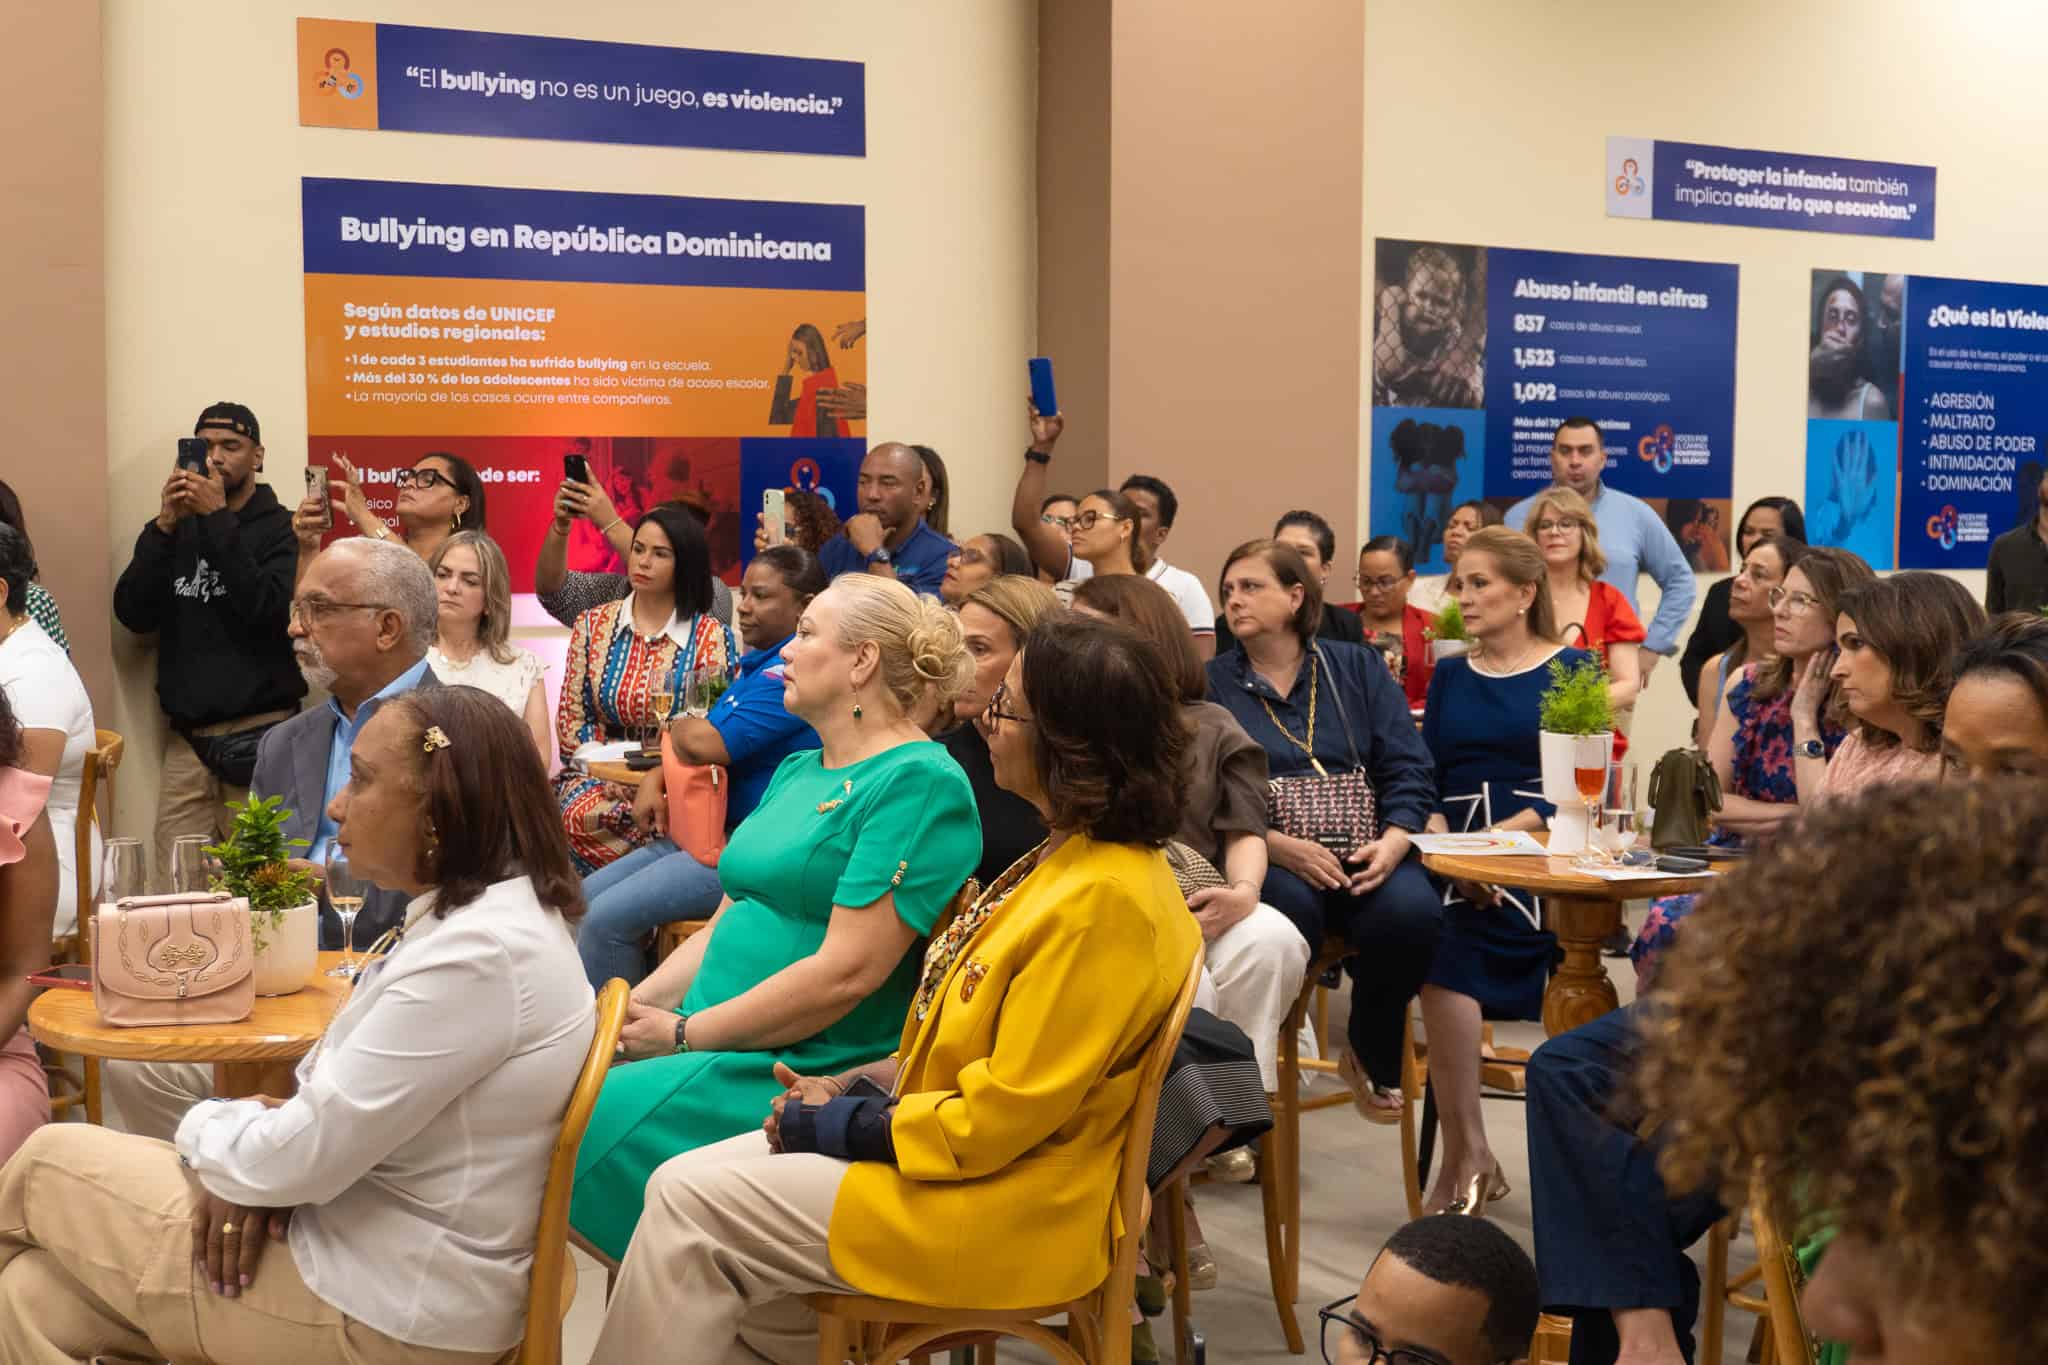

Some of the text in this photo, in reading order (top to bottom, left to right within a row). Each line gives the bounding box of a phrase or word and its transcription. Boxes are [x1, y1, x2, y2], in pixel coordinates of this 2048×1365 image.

[406, 66, 843, 115] “El bullying no es un juego, es violencia.”
[1685, 159, 1908, 197] “Proteger la infancia también
[1675, 184, 1732, 207] implica
[1734, 189, 1786, 209] cuidar
[1787, 193, 1802, 211] lo
[1804, 198, 1833, 216] que
[341, 216, 832, 262] Bullying en República Dominicana
[1514, 278, 1709, 309] Abuso infantil en cifras
[344, 302, 555, 323] Según datos de UNICEF
[1928, 304, 1970, 328] ¿Qué
[1970, 311, 1989, 327] es
[1990, 308, 2006, 328] la
[344, 323, 546, 343] y estudios regionales:
[1513, 314, 1545, 332] 837
[351, 354, 358, 365] 1
[360, 354, 378, 366] de
[380, 354, 416, 366] cada
[418, 355, 426, 366] 3
[428, 355, 507, 368] estudiantes
[510, 356, 526, 368] ha
[529, 357, 575, 370] sufrido
[577, 357, 628, 372] bullying
[630, 360, 646, 370] en
[649, 359, 660, 370] la
[1513, 348, 1555, 369] 1,523
[353, 372, 382, 384] Más
[384, 372, 406, 384] del
[409, 373, 424, 384] 30
[427, 373, 438, 385] %
[441, 373, 458, 385] de
[461, 373, 480, 385] los
[482, 374, 571, 387] adolescentes
[574, 375, 590, 387] ha
[592, 375, 619, 387] sido
[668, 377, 684, 389] de
[687, 379, 724, 389] acoso
[353, 391, 673, 407] La mayoría de los casos ocurre entre compañeros.
[1513, 382, 1557, 404] 1,092
[1929, 390, 1995, 410] AGRESIÓN
[1929, 413, 1996, 431] MALTRATO
[1929, 433, 2036, 452] ABUSO DE PODER
[1928, 453, 2016, 472] INTIMIDACIÓN
[507, 470, 541, 483] ser:
[1928, 474, 2012, 493] DOMINACIÓN
